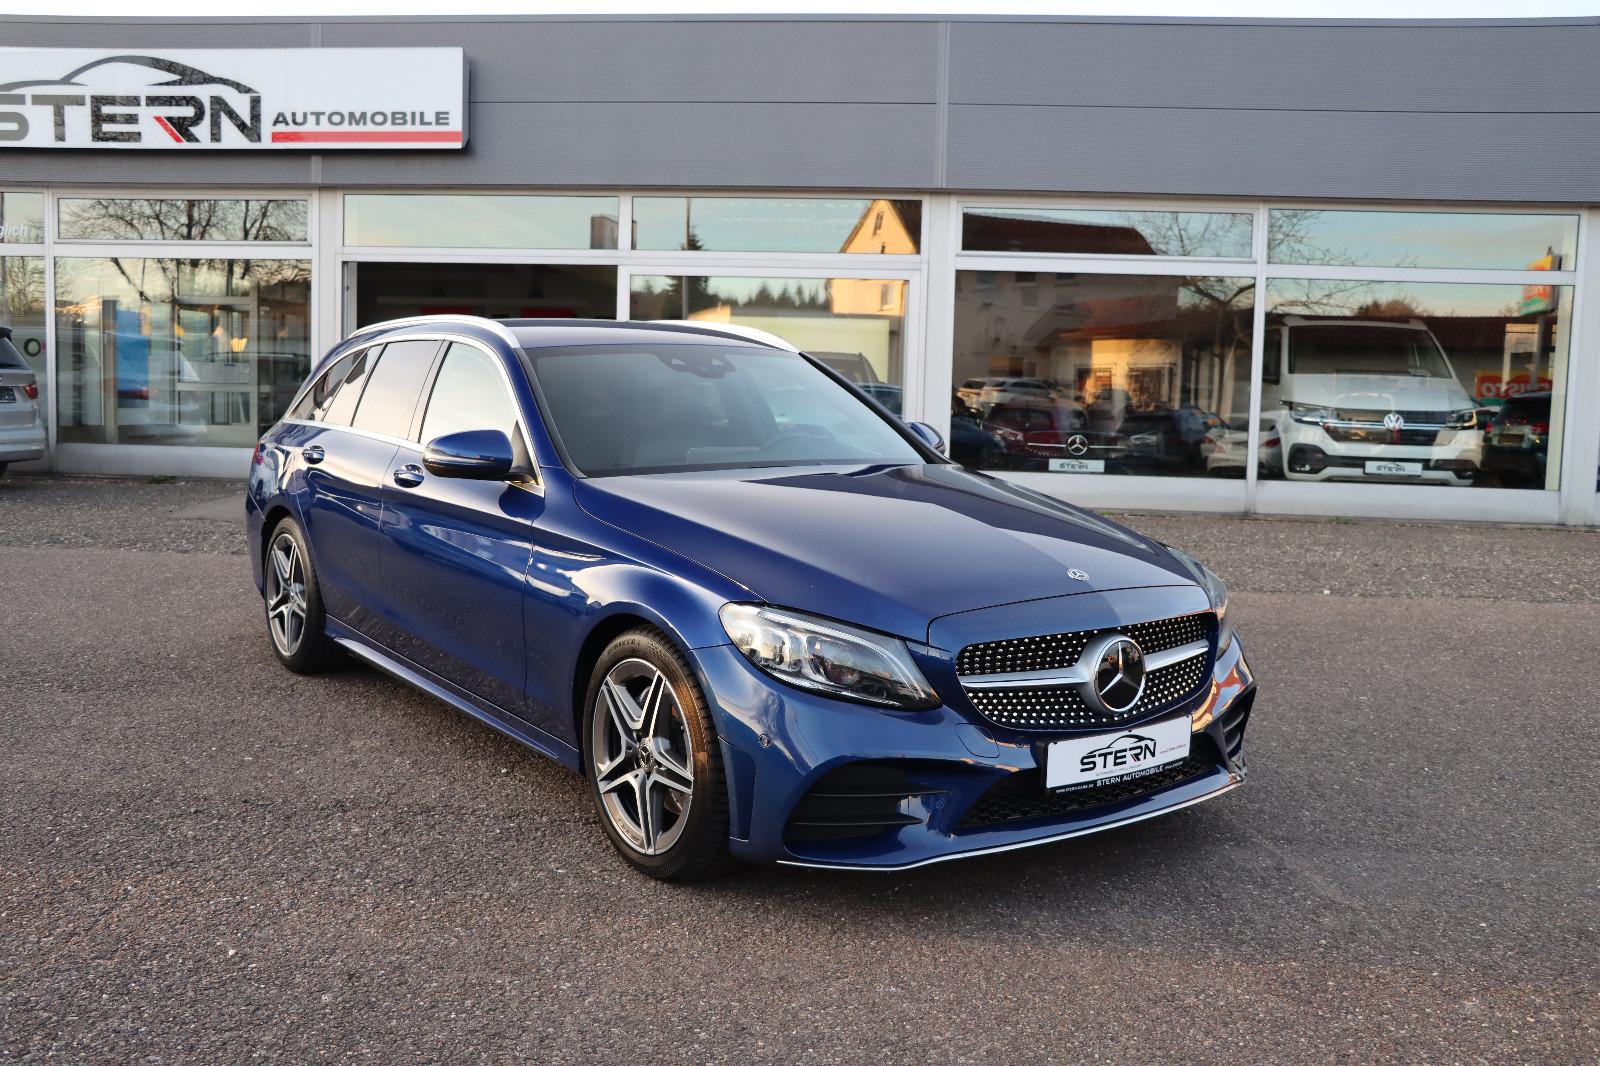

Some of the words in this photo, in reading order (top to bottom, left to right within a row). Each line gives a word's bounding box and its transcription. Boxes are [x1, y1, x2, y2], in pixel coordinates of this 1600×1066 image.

[272, 111, 450, 127] AUTOMOBILE
[1059, 462, 1089, 470] STERN
[1080, 741, 1157, 772] STERN
[1096, 776, 1121, 787] STERN
[1122, 765, 1164, 782] AUTOMOBILE
